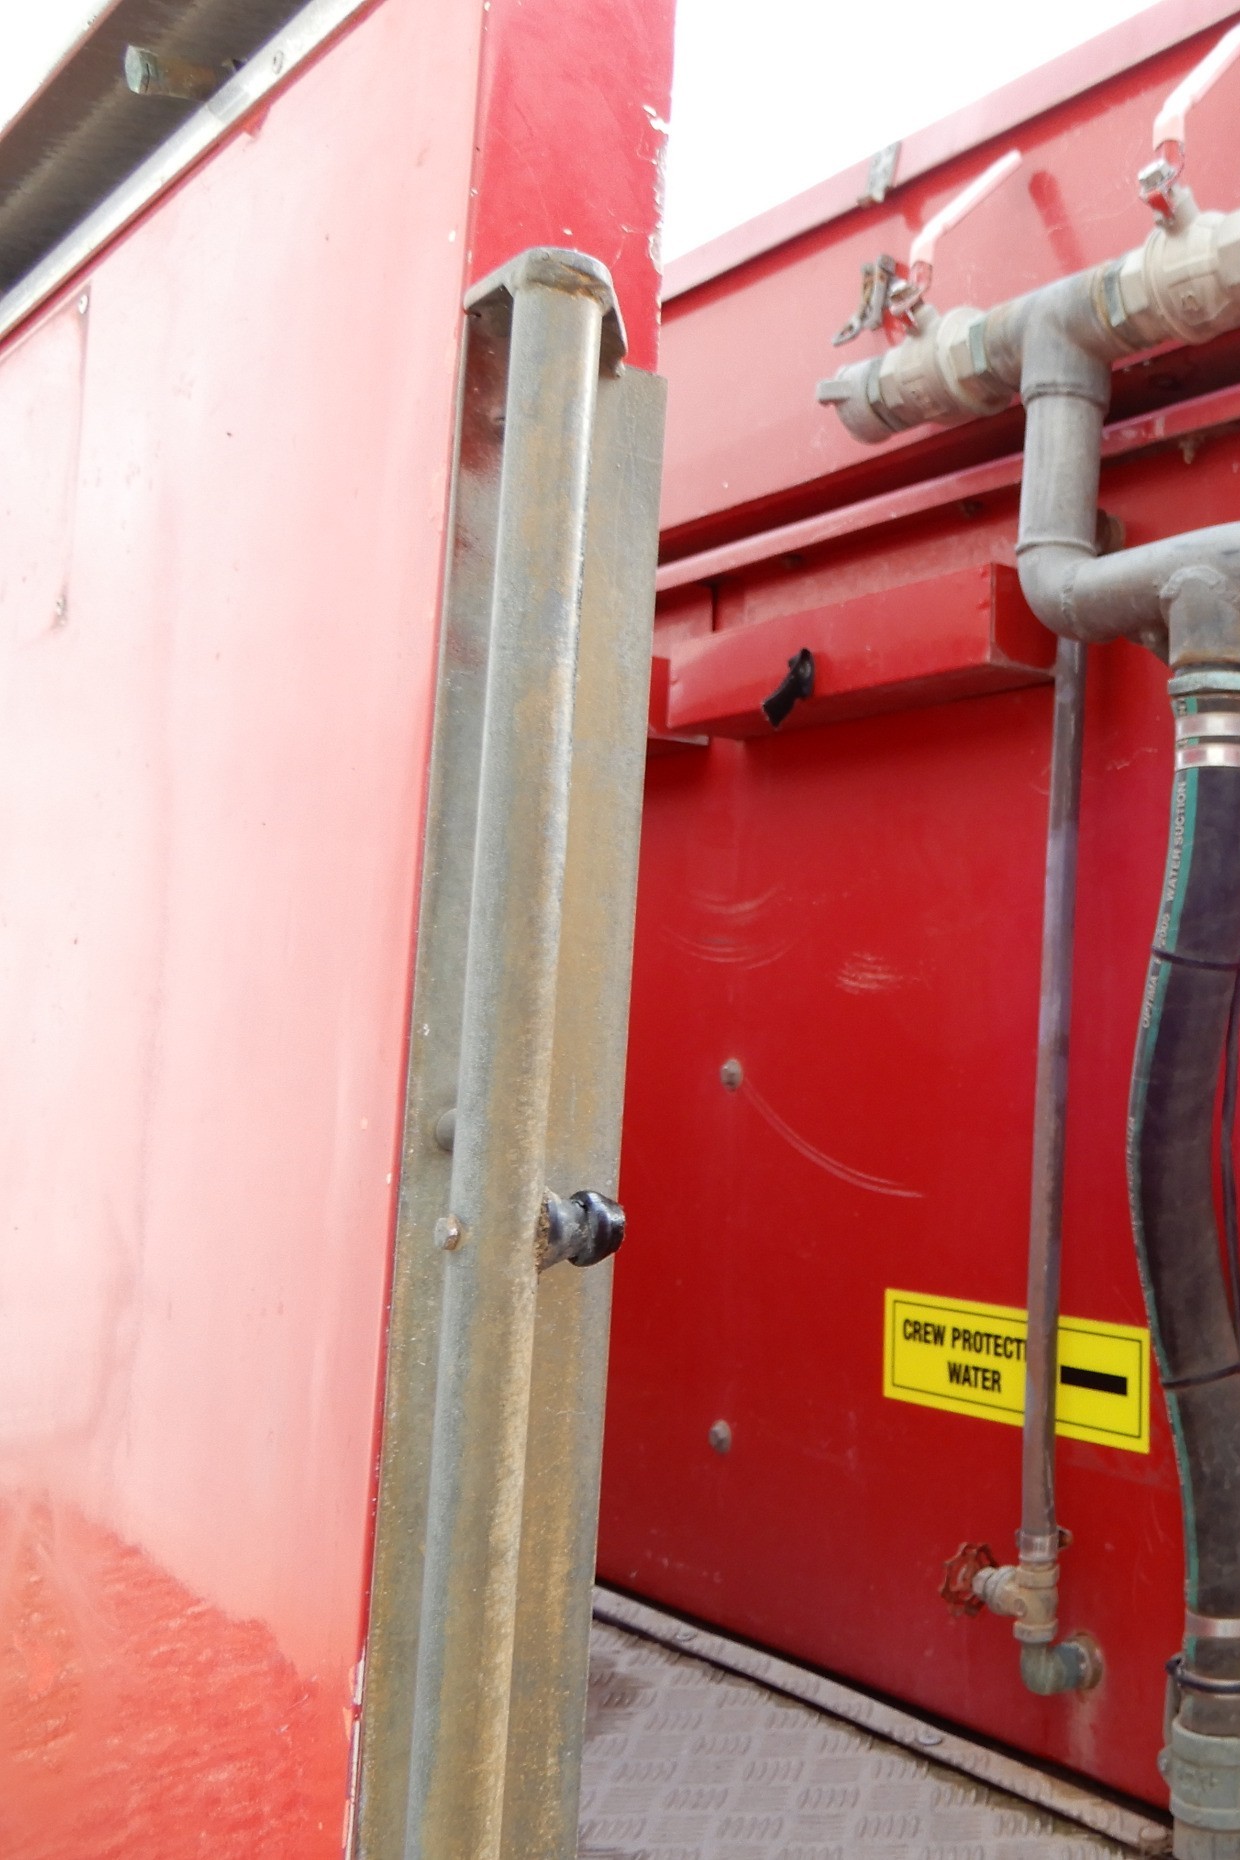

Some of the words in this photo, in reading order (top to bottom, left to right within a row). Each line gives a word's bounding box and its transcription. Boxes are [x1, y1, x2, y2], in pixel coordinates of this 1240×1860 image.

[1173, 782, 1187, 845] SUCTION
[1166, 848, 1181, 902] WATER
[903, 1318, 946, 1347] CREW
[951, 1327, 1027, 1363] PROTECTI
[947, 1361, 1002, 1393] WATER
